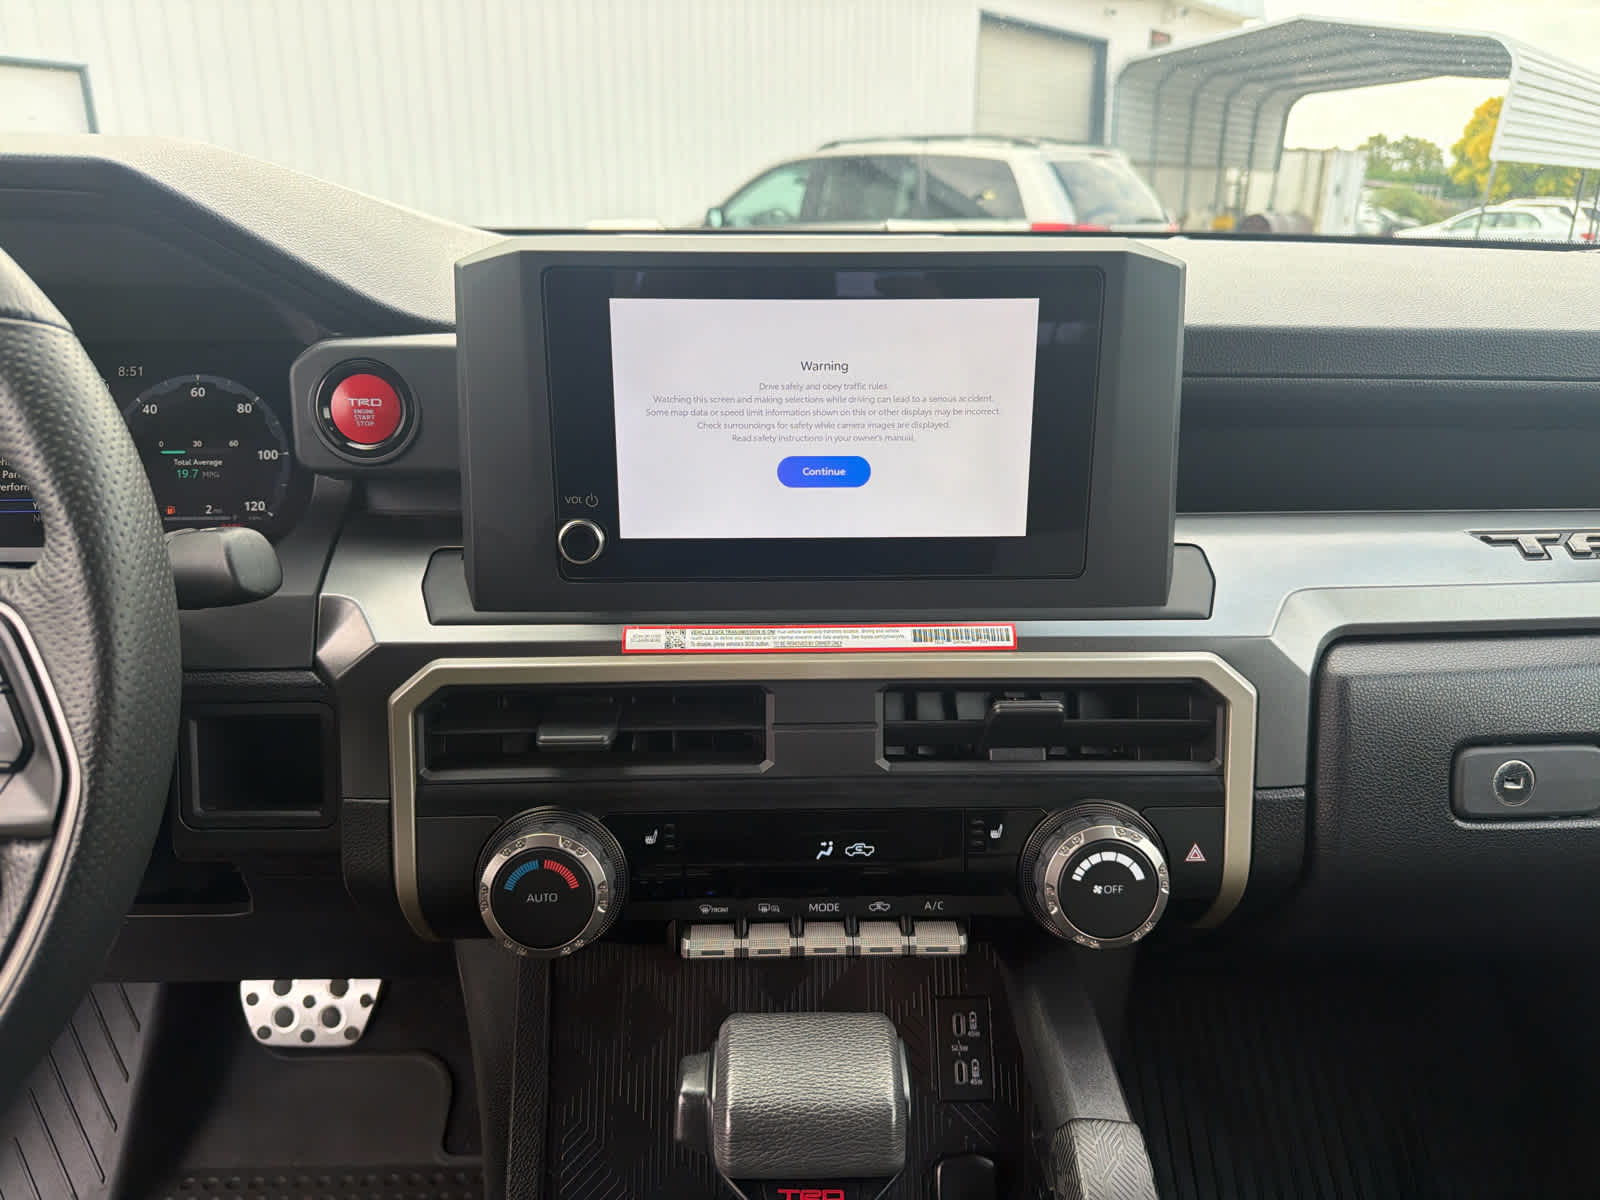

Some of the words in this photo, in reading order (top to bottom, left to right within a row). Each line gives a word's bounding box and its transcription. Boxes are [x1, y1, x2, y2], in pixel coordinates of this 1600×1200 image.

[118, 366, 144, 377] 8:51
[801, 361, 848, 374] Warning
[191, 387, 206, 398] 60
[760, 382, 779, 390] Drive
[781, 382, 804, 392] safely
[805, 382, 820, 390] and
[822, 382, 842, 392] obey
[844, 382, 867, 390] traffic
[347, 398, 382, 407] TRD
[653, 394, 692, 405] Watching
[693, 394, 706, 403] this
[738, 394, 752, 403] and
[754, 394, 784, 405] making
[785, 394, 824, 403] selections
[826, 394, 847, 403] while
[848, 394, 875, 405] driving
[893, 394, 910, 403] lead
[912, 394, 920, 403] to
[929, 394, 957, 403] serious
[142, 404, 158, 415] 40
[236, 403, 252, 414] 80
[646, 408, 669, 416] Some
[671, 410, 689, 418] map
[690, 408, 708, 416] data
[720, 408, 744, 418] speed
[746, 408, 763, 416] limit
[765, 408, 811, 416] information
[812, 408, 839, 416] shown
[852, 408, 866, 416] this
[878, 408, 899, 416] other
[901, 408, 932, 418] displays
[934, 410, 951, 418] may
[953, 408, 964, 416] be
[696, 420, 722, 430] Check
[724, 420, 776, 432] surroundings
[777, 420, 788, 430] for
[790, 420, 813, 432] safety
[815, 420, 836, 430] while
[868, 420, 896, 432] images
[732, 433, 752, 442] Read
[754, 433, 777, 444] safety
[778, 433, 824, 442] instructions
[825, 433, 833, 442] in
[834, 435, 852, 444] your
[257, 450, 278, 461] 100
[174, 458, 192, 466] Total
[193, 458, 223, 468] Average
[176, 468, 199, 480] 19.7
[802, 466, 847, 477] Continue
[565, 496, 583, 504] VOL
[205, 504, 212, 514] 2
[244, 501, 266, 512] 120
[1103, 884, 1124, 894] OFF
[527, 892, 559, 903] AUTO
[808, 902, 841, 912] MODE
[924, 901, 945, 911] A/C
[777, 1188, 846, 1200] TRD
